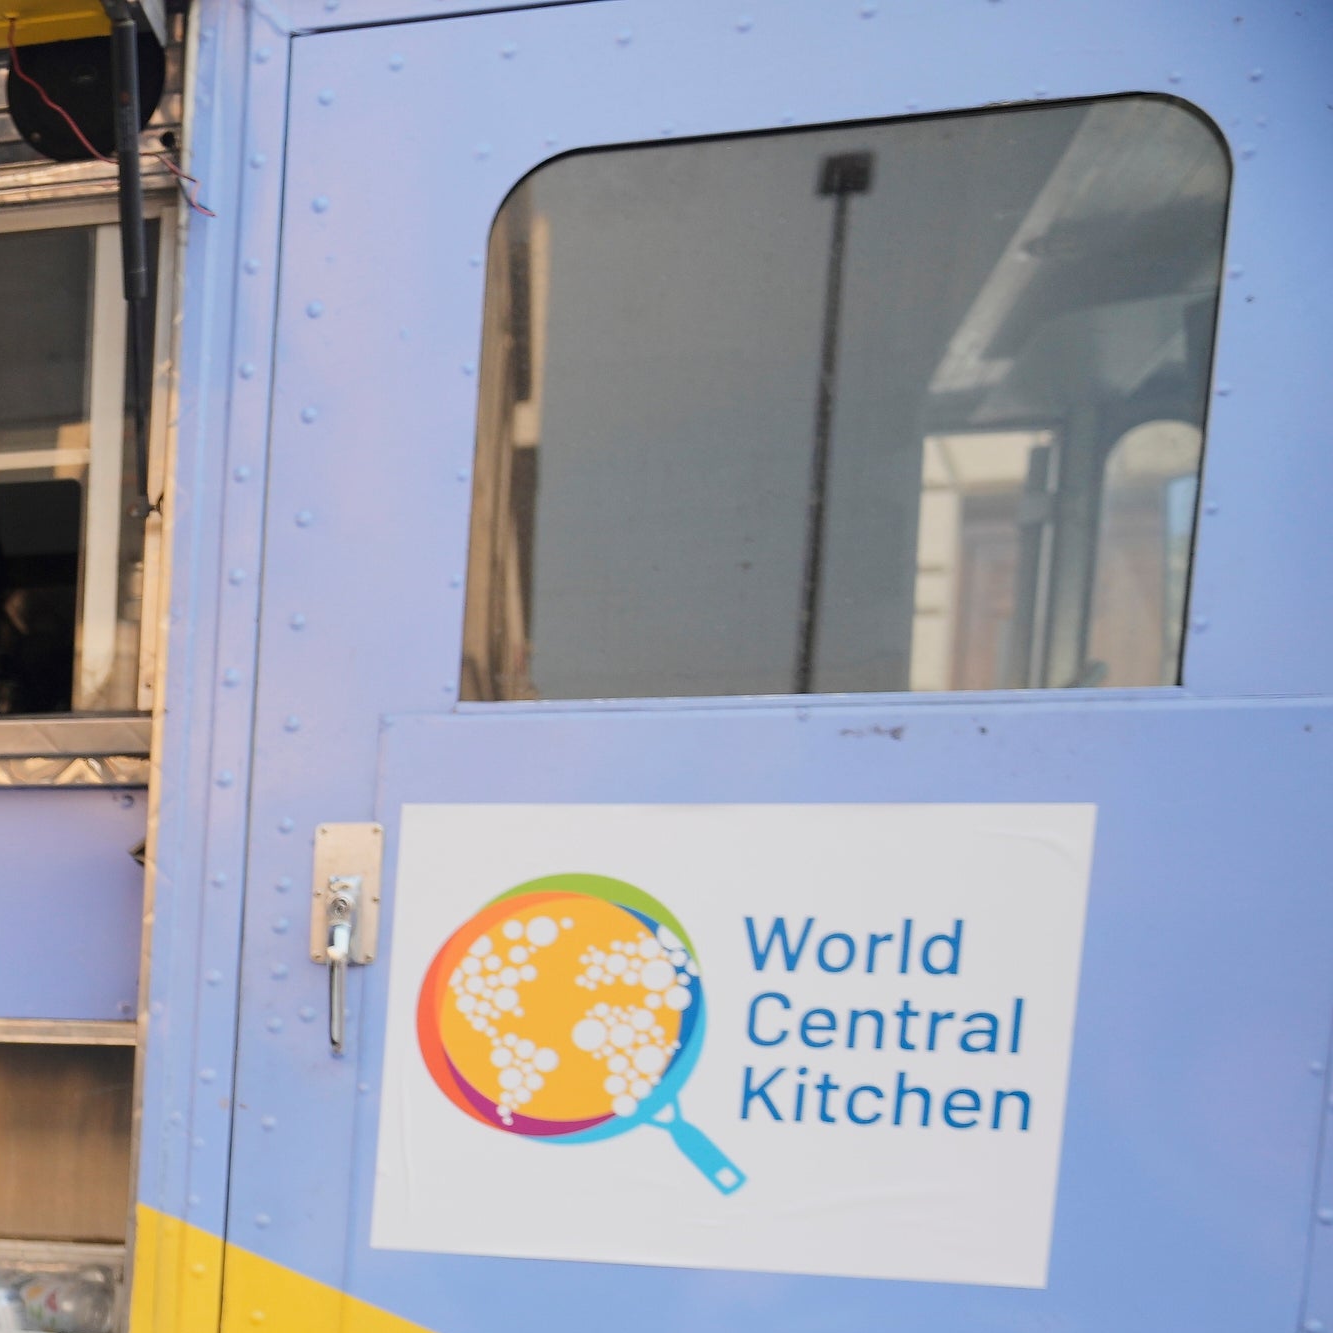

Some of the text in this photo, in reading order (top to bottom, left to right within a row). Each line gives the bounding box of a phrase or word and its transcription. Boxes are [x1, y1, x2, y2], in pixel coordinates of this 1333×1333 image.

[744, 916, 964, 975] World
[747, 992, 1024, 1053] Central
[740, 1066, 1032, 1131] Kitchen
